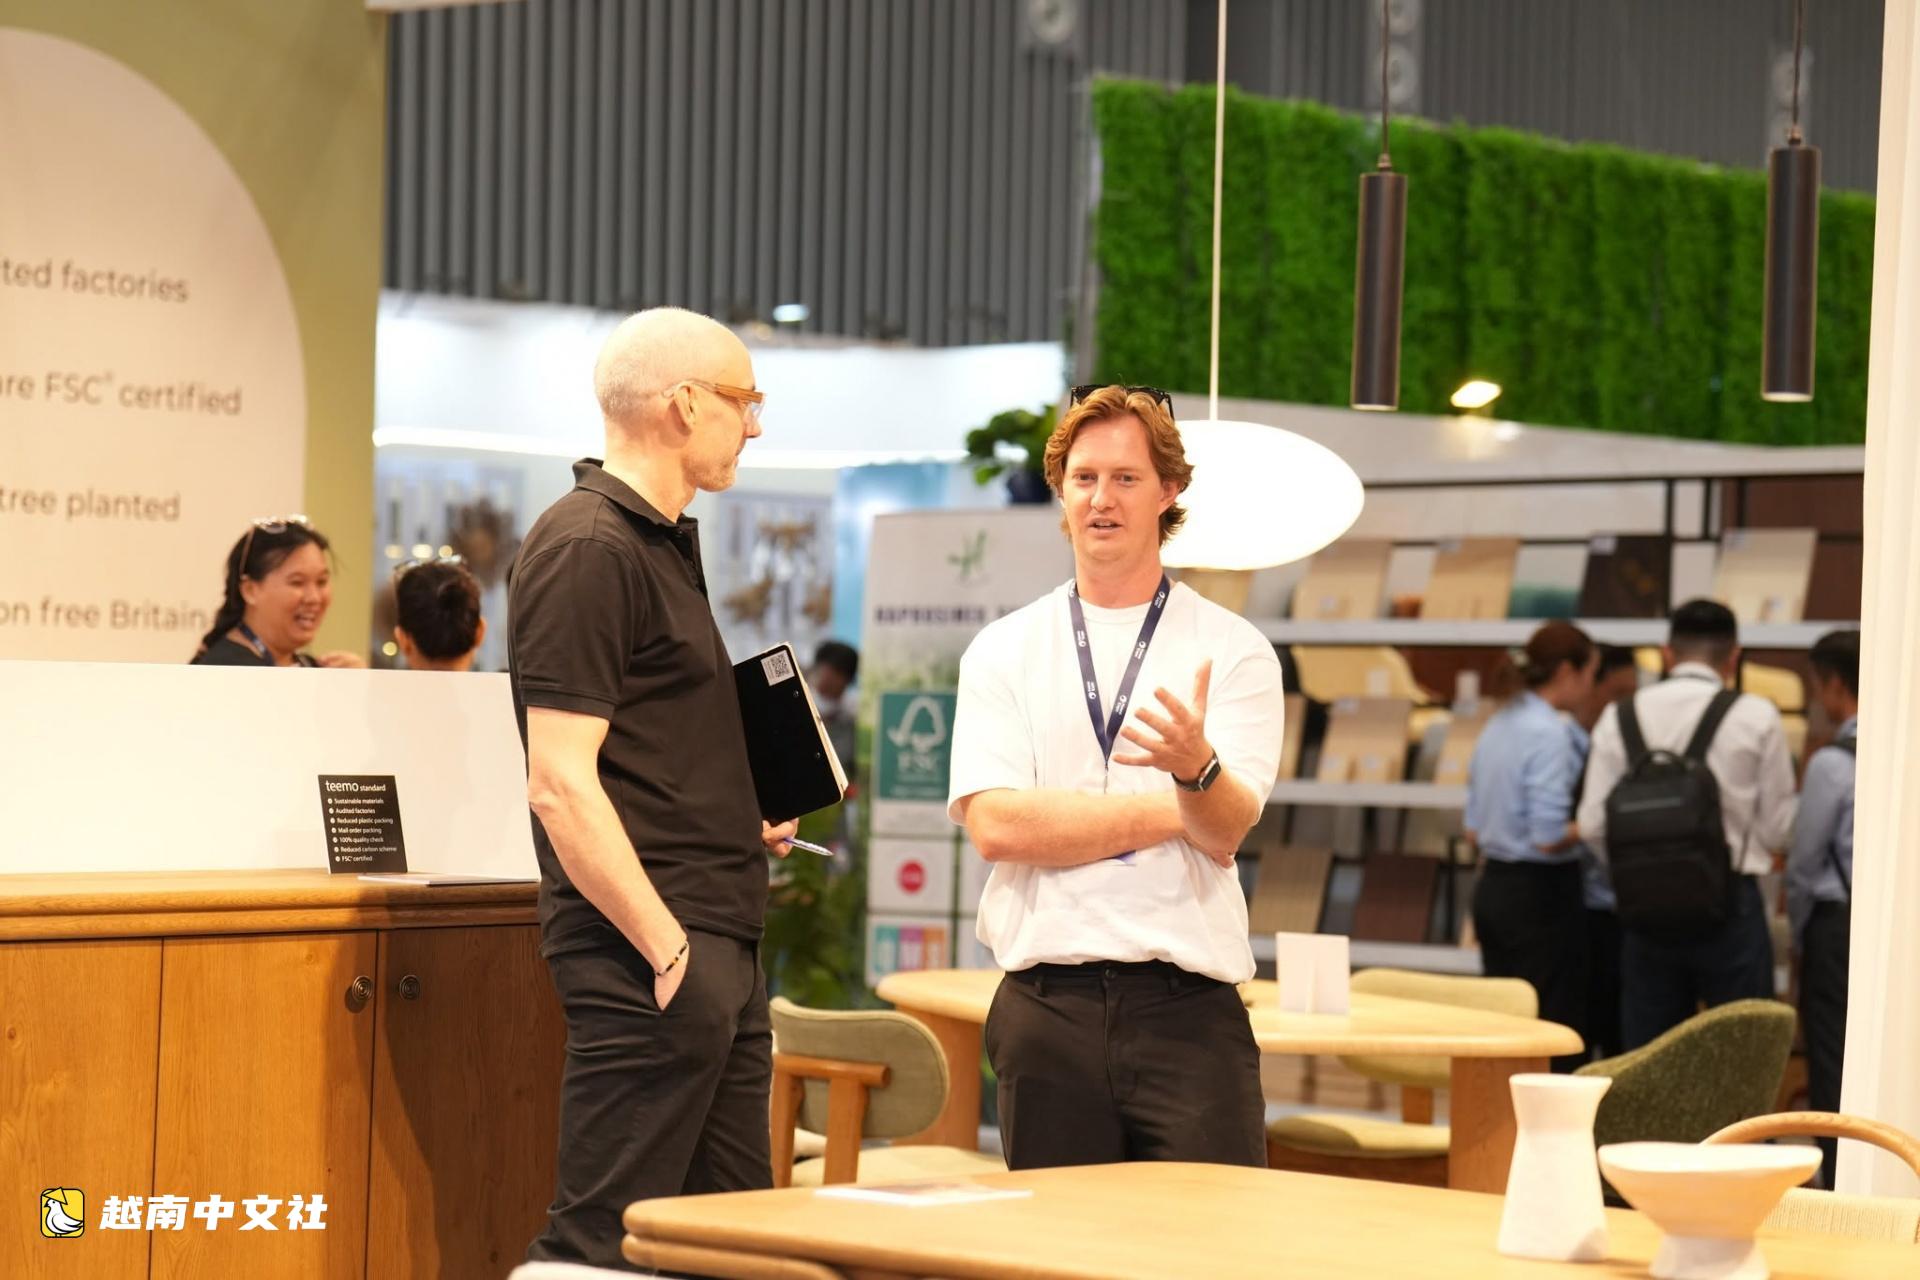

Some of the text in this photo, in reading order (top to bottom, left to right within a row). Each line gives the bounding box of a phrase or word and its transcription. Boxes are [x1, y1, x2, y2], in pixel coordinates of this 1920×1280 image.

[62, 259, 189, 303] factories
[0, 374, 35, 401] re
[118, 383, 243, 416] certified
[66, 488, 181, 522] planted
[40, 594, 100, 629] free
[325, 780, 386, 792] teemo standard
